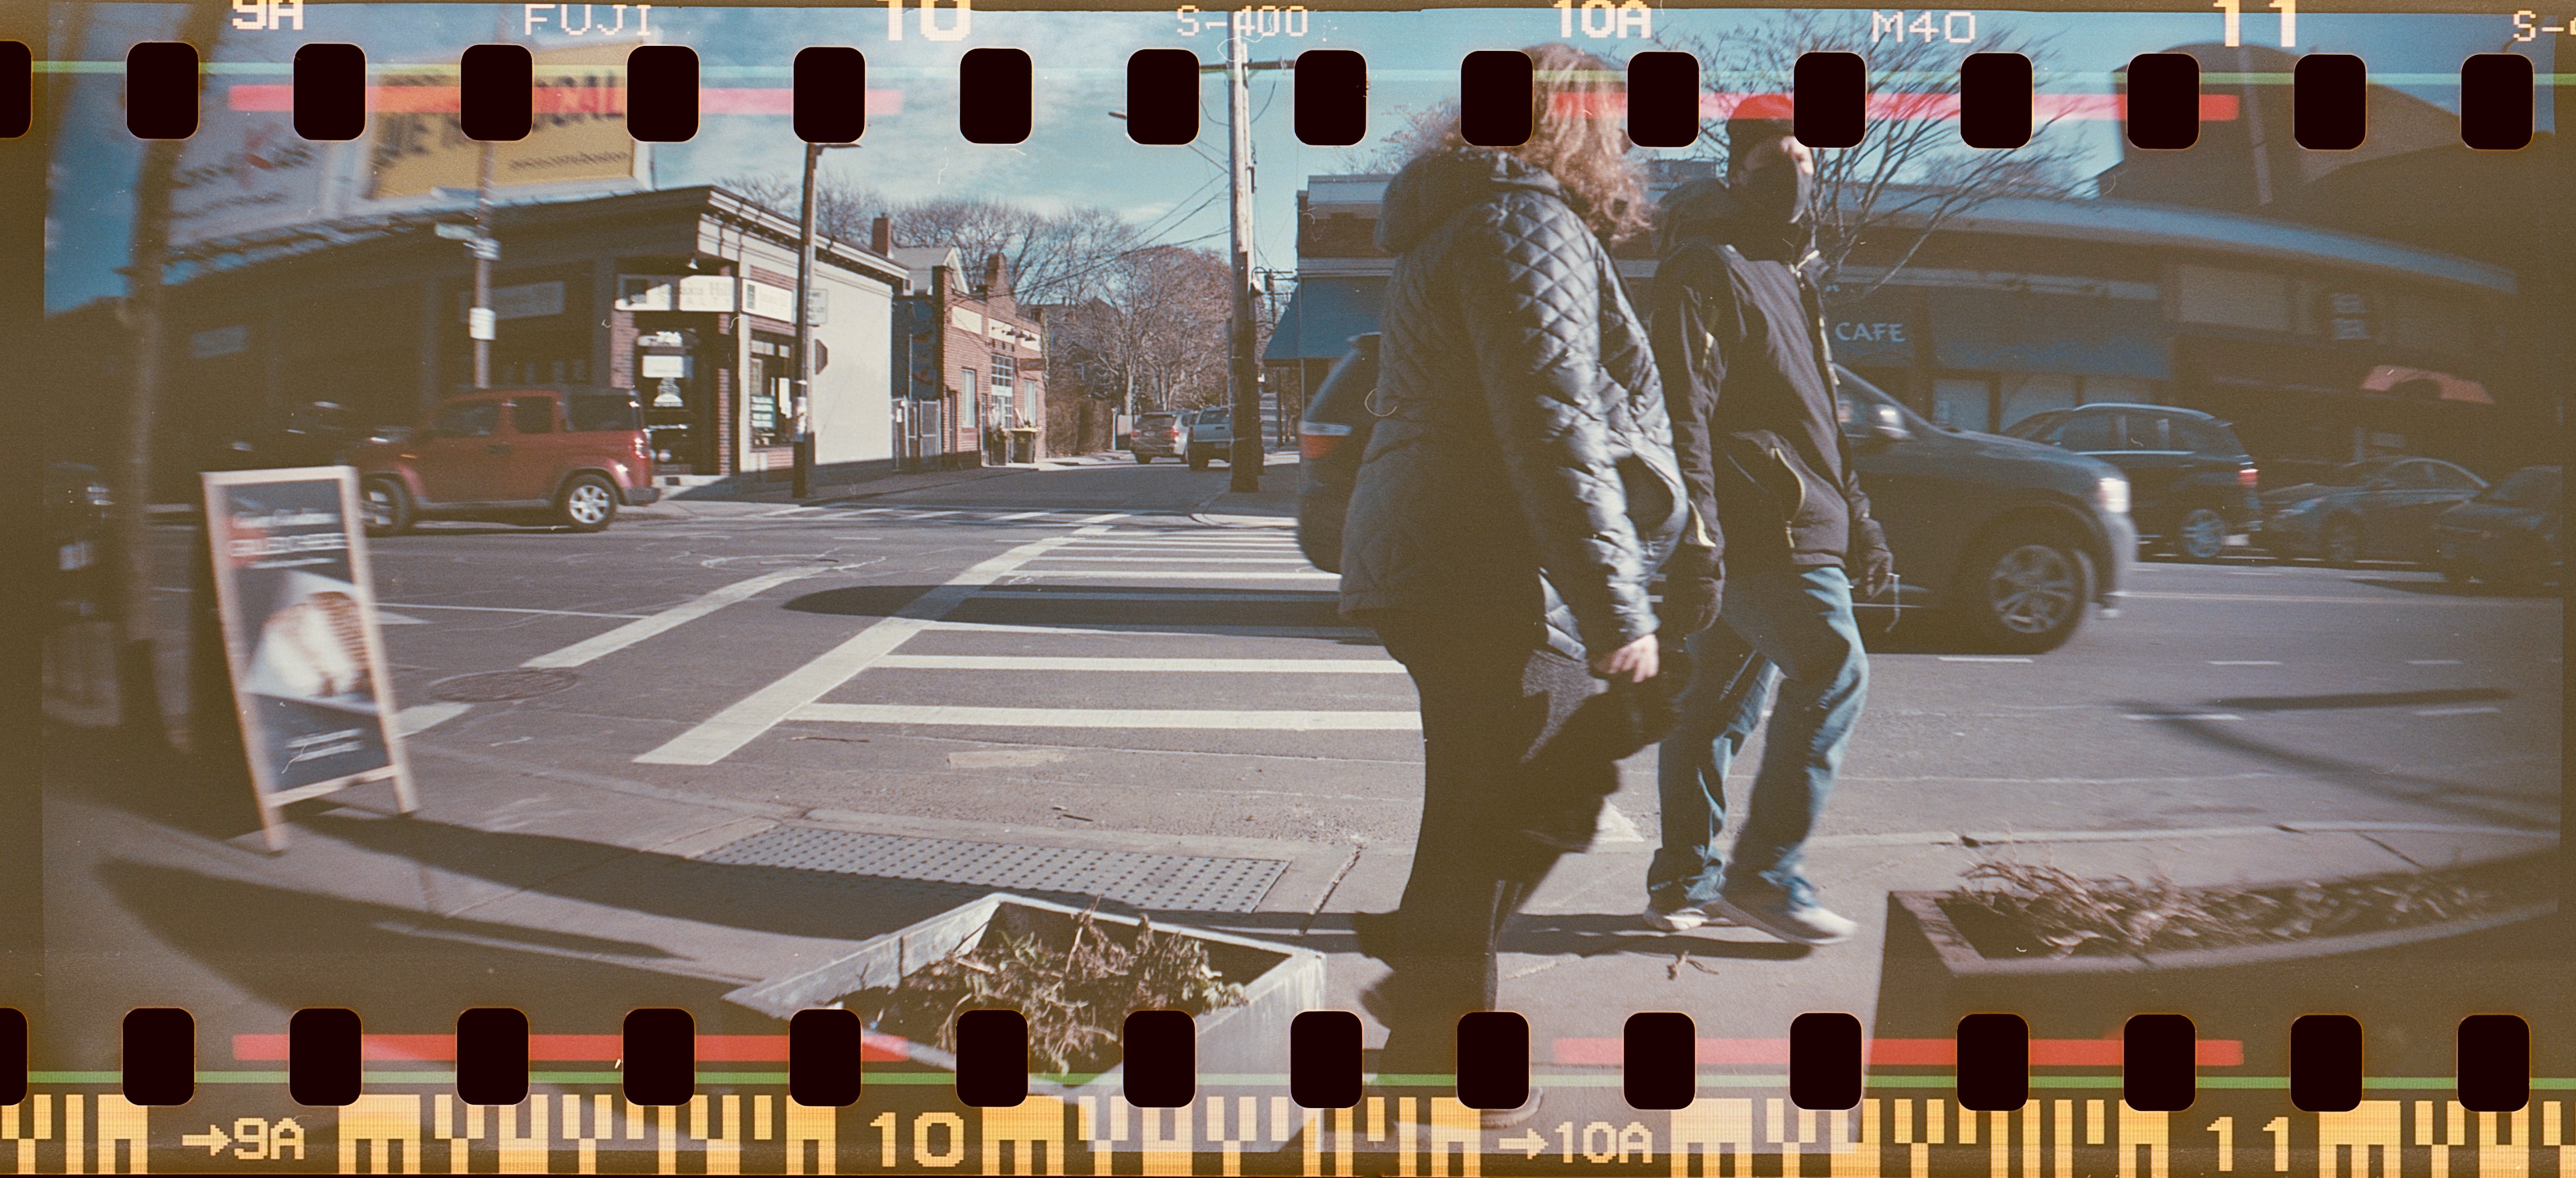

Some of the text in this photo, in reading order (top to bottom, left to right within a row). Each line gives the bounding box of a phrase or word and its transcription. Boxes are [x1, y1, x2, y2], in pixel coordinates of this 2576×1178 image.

[525, 3, 652, 36] FUJI
[877, 0, 971, 41] 10
[1176, 5, 1308, 38] S-400
[1553, 0, 1652, 39] 10A
[2213, 0, 2296, 47] 11
[1835, 322, 1906, 343] CAFE
[234, 1118, 304, 1160] 9A
[870, 1112, 964, 1167] 10
[1555, 1121, 1653, 1163] 10A
[2207, 1116, 2289, 1172] 11
